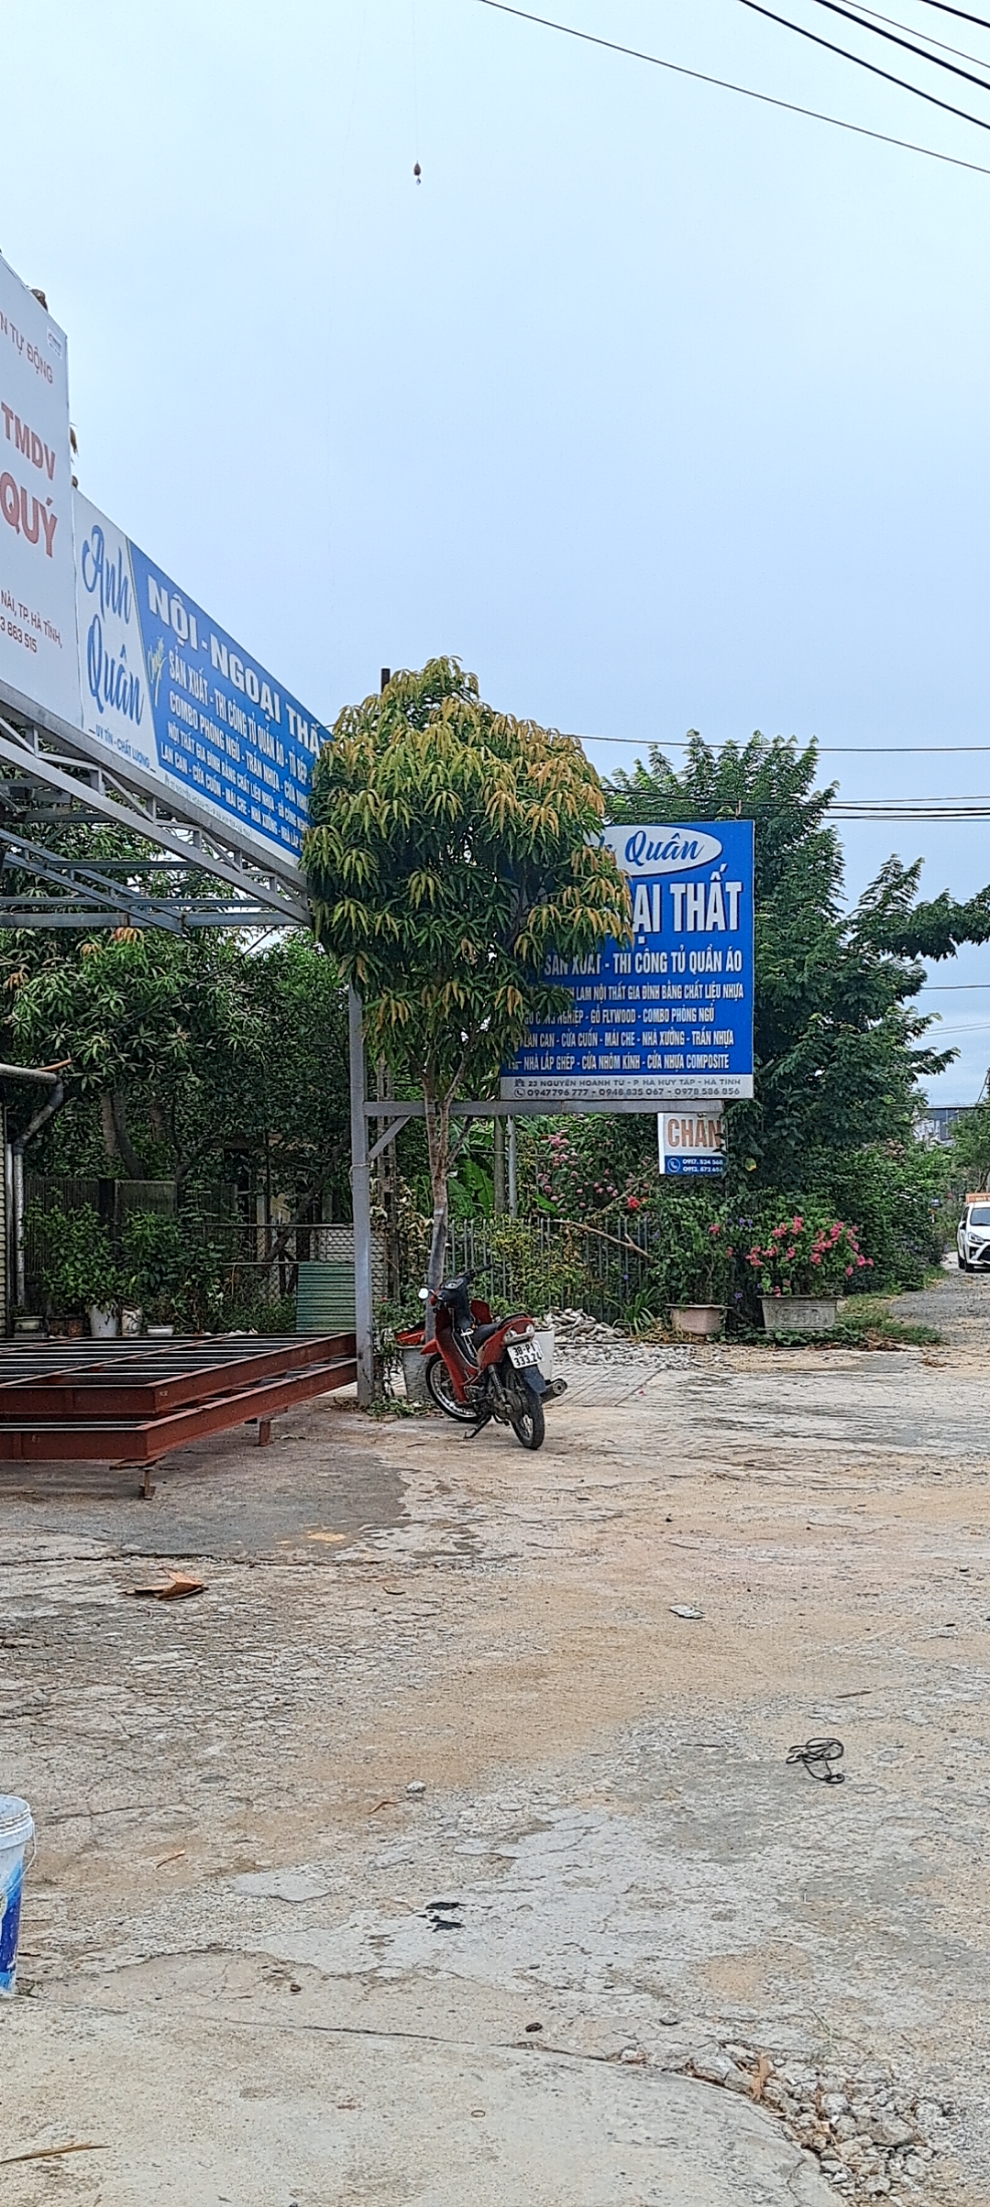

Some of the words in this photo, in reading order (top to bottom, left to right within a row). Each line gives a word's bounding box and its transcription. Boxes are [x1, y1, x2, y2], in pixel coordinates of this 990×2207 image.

[26, 341, 53, 384] ĐỘNG
[1, 402, 56, 480] TMDV
[0, 471, 58, 558] QUÝ
[81, 524, 132, 625] Anh
[7, 621, 23, 643] 863
[24, 633, 37, 653] 515
[148, 574, 198, 651] NỘI
[210, 632, 282, 724] NGOẠI
[87, 612, 145, 726] Quân
[169, 645, 187, 690] SẢN
[188, 667, 208, 707] XUẤT
[214, 687, 227, 722] THI
[227, 698, 248, 739] CÔNG
[169, 690, 198, 731] COMBO
[199, 713, 225, 751] PHÒNG
[161, 741, 174, 765] LAN
[174, 751, 188, 775] CAN
[625, 830, 704, 867] Quân
[669, 863, 742, 932] THẤT
[613, 953, 631, 974] THI
[635, 948, 668, 974] CÔNG
[671, 944, 686, 973] TỦ
[689, 943, 722, 975] QUẦN
[725, 946, 742, 973] ÁO
[608, 980, 627, 1001] THẤT
[628, 985, 640, 1000] GIA
[723, 982, 744, 1002] NHỰA
[603, 1009, 636, 1024] FLYWOOD
[643, 1008, 669, 1023] COMBO
[671, 1004, 697, 1022] PHÒNG
[540, 1033, 555, 1048] CAN
[621, 1031, 636, 1046] CHE
[686, 1053, 729, 1069] COMPOSITE
